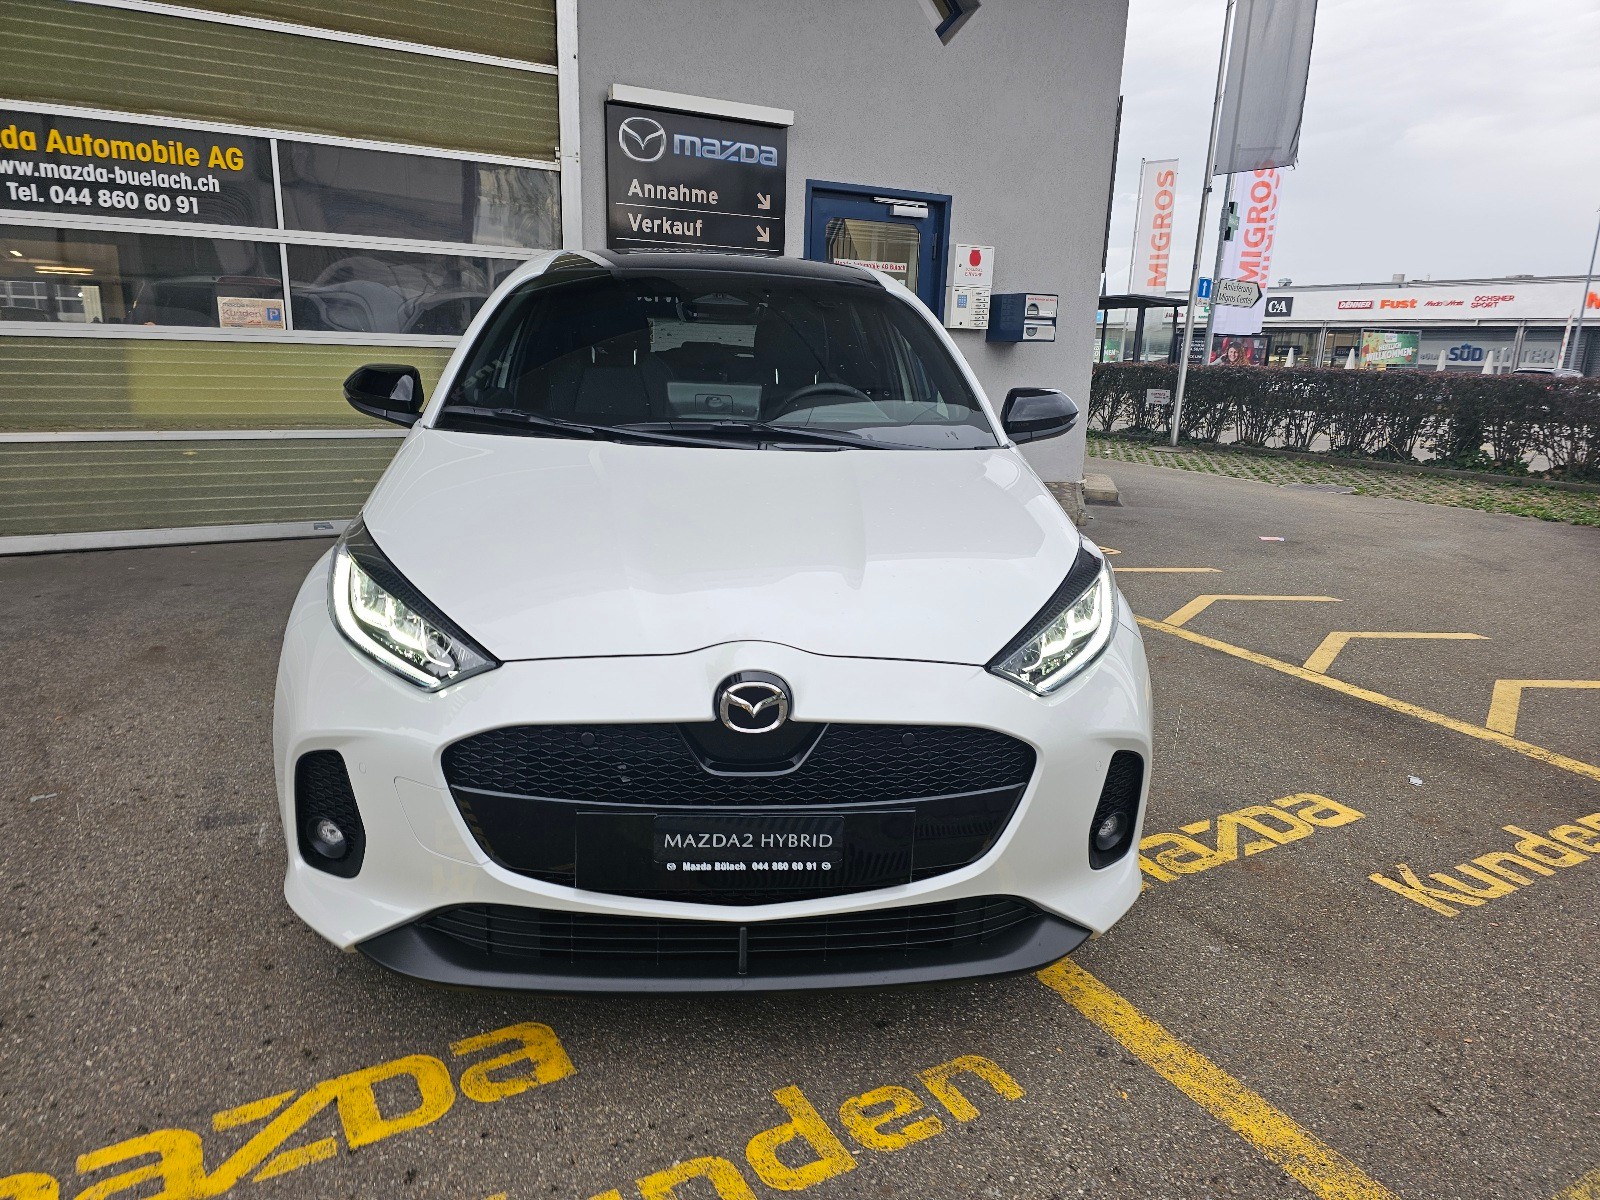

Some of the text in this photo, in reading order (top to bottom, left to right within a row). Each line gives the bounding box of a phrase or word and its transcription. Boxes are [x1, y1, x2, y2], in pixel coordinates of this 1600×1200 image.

[0, 124, 244, 171] da Automobile AG
[673, 133, 778, 167] mazda
[6, 181, 199, 214] Tel. 044 860 60 91
[627, 178, 719, 205] Annahme
[627, 212, 703, 237] Verkauf
[1147, 169, 1175, 287] MIGROS
[1223, 282, 1253, 296] Anlieferung
[1219, 293, 1236, 304] Migros
[1268, 300, 1287, 313] C&A
[1339, 301, 1372, 309] DENNER
[1470, 301, 1499, 309] SPORT
[1366, 346, 1412, 361] WILLKOMMEN
[1449, 343, 1483, 362] SÜD
[664, 833, 833, 849] MAZDA2 HYBRID
[682, 861, 817, 872] Mazda Bülach 044 860 60 91
